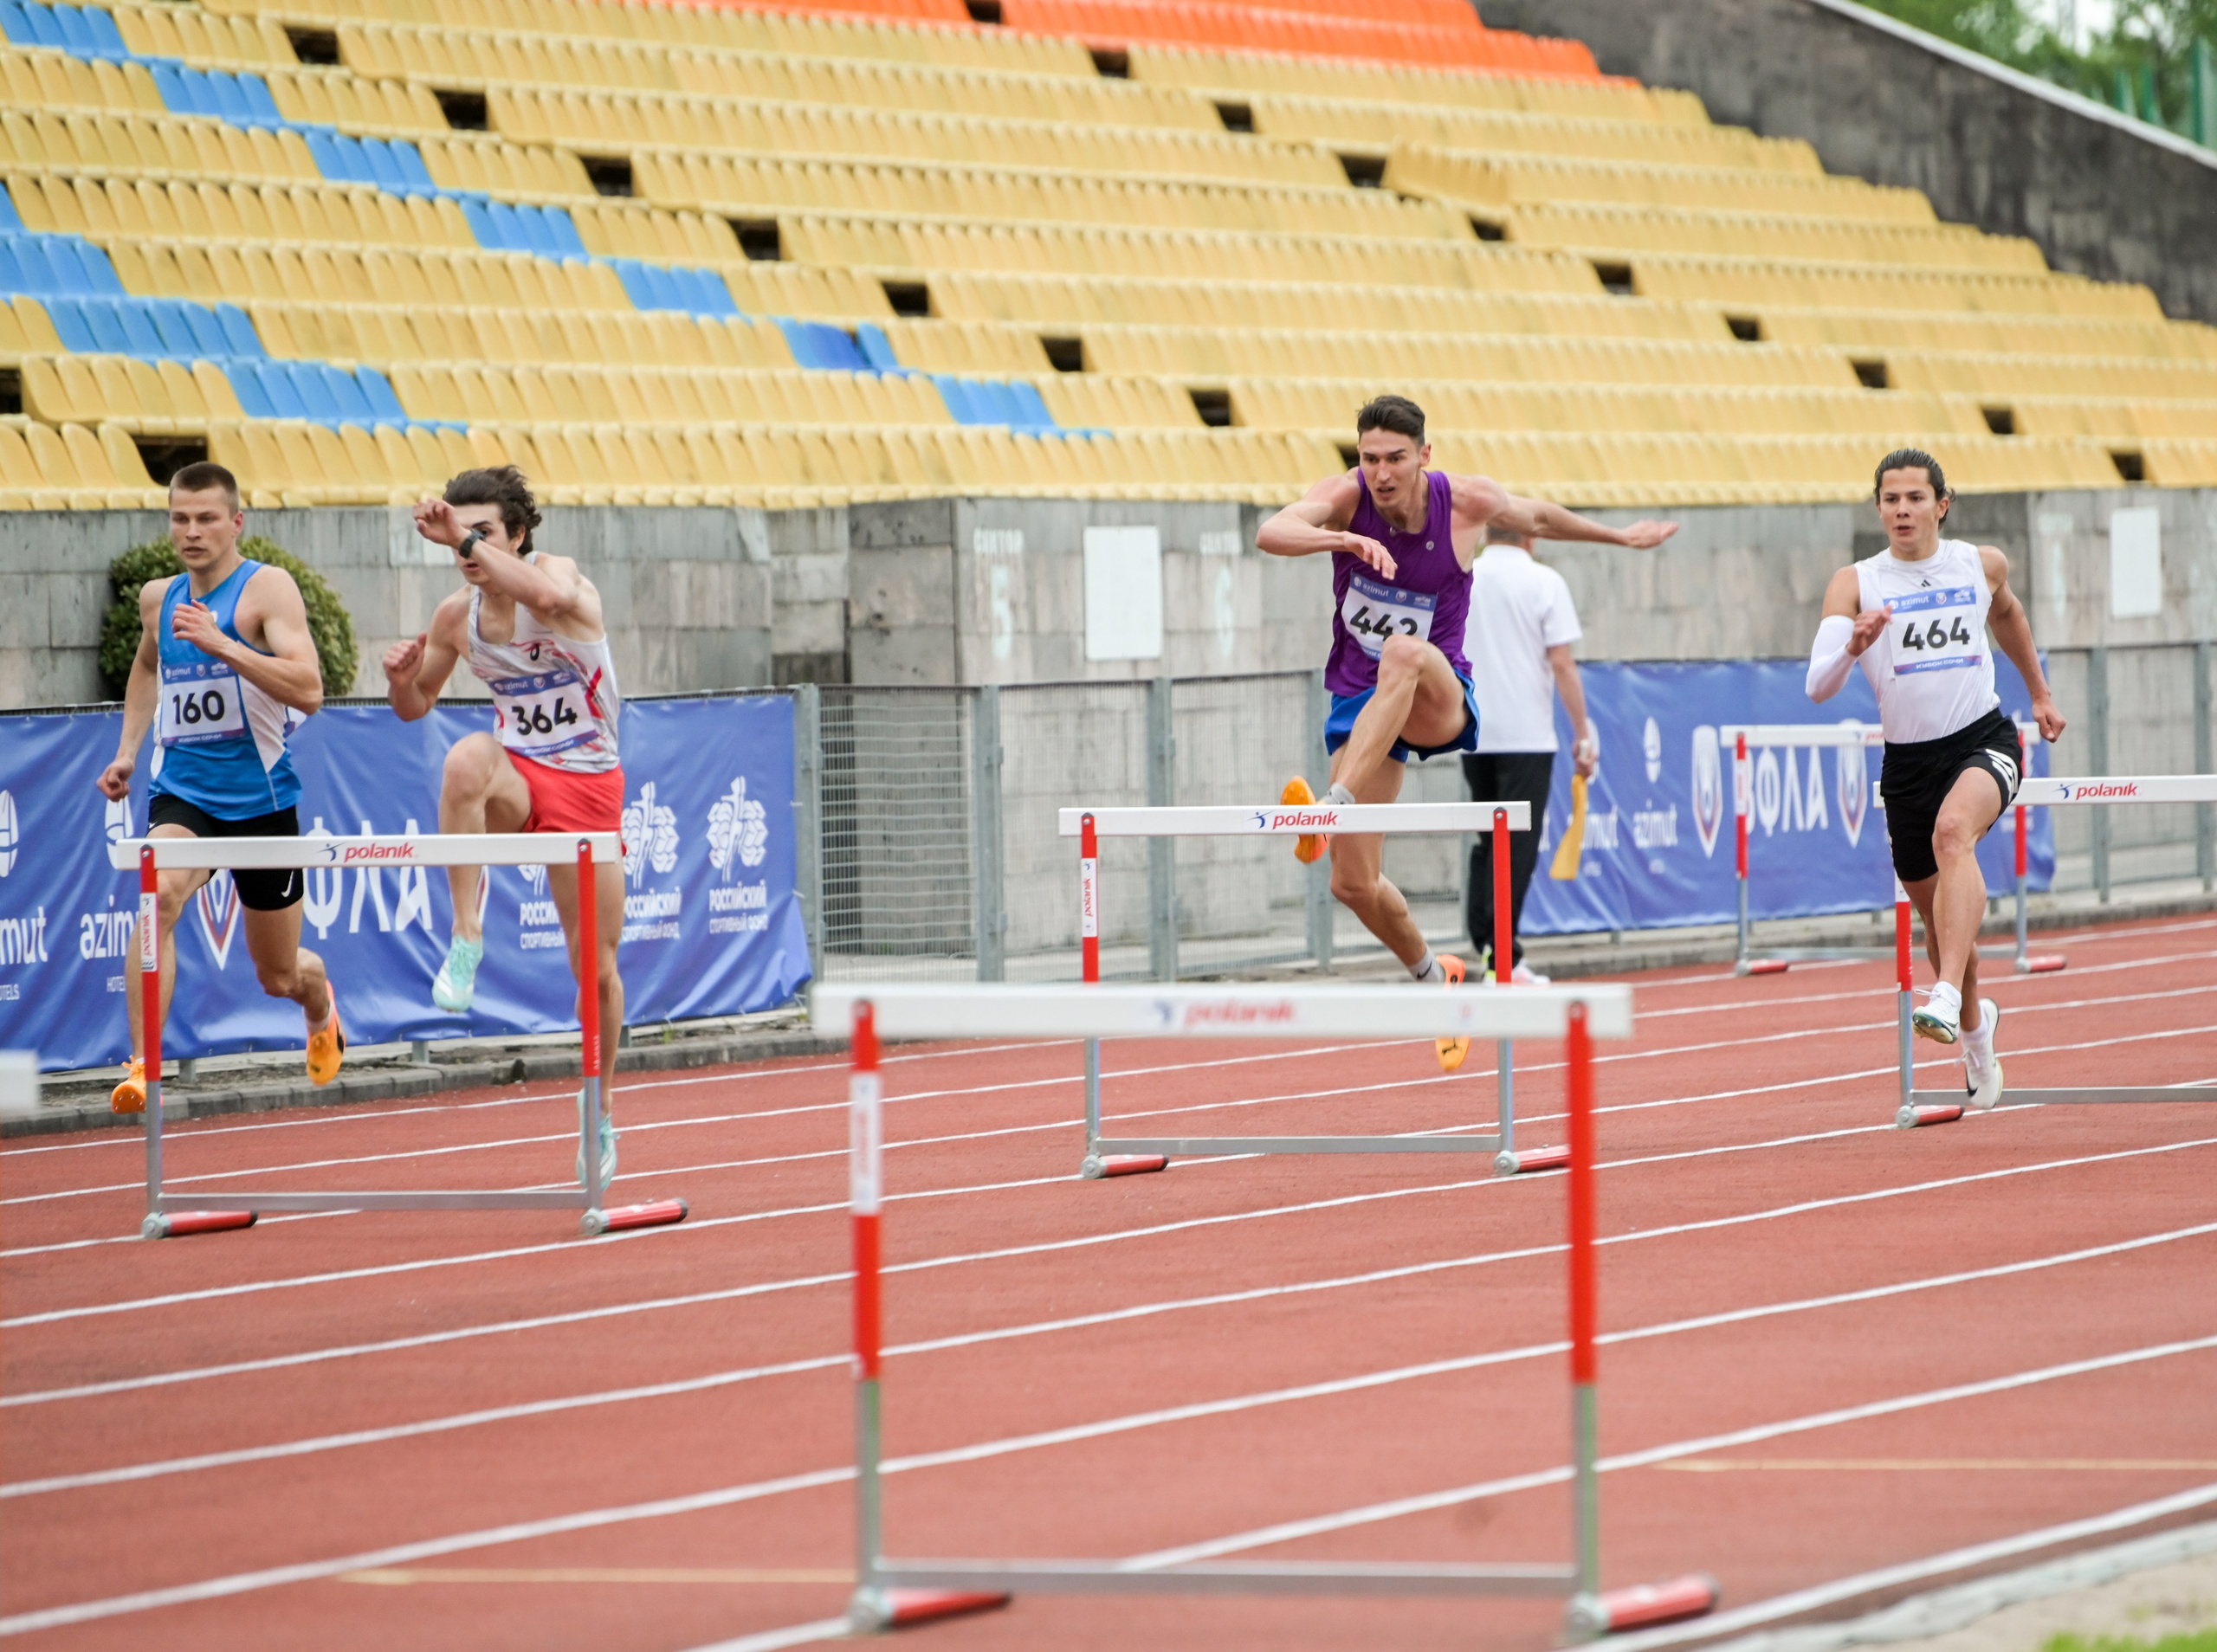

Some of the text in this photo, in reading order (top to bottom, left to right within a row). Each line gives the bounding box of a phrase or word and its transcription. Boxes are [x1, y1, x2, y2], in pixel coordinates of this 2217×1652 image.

[1362, 583, 1389, 597] azimut
[1901, 596, 1929, 605] azimut
[1902, 616, 1970, 651] 464
[171, 667, 191, 676] azimut
[504, 680, 528, 691] azimut
[172, 690, 225, 725] 160
[512, 697, 578, 735] 364
[2076, 782, 2138, 801] polanik
[1272, 810, 1338, 829] polanik
[344, 842, 414, 862] polanik
[624, 886, 682, 919] ОССИЙСКИЙ
[708, 879, 767, 912] РОССИЙСКИЙ
[80, 894, 139, 959] azim
